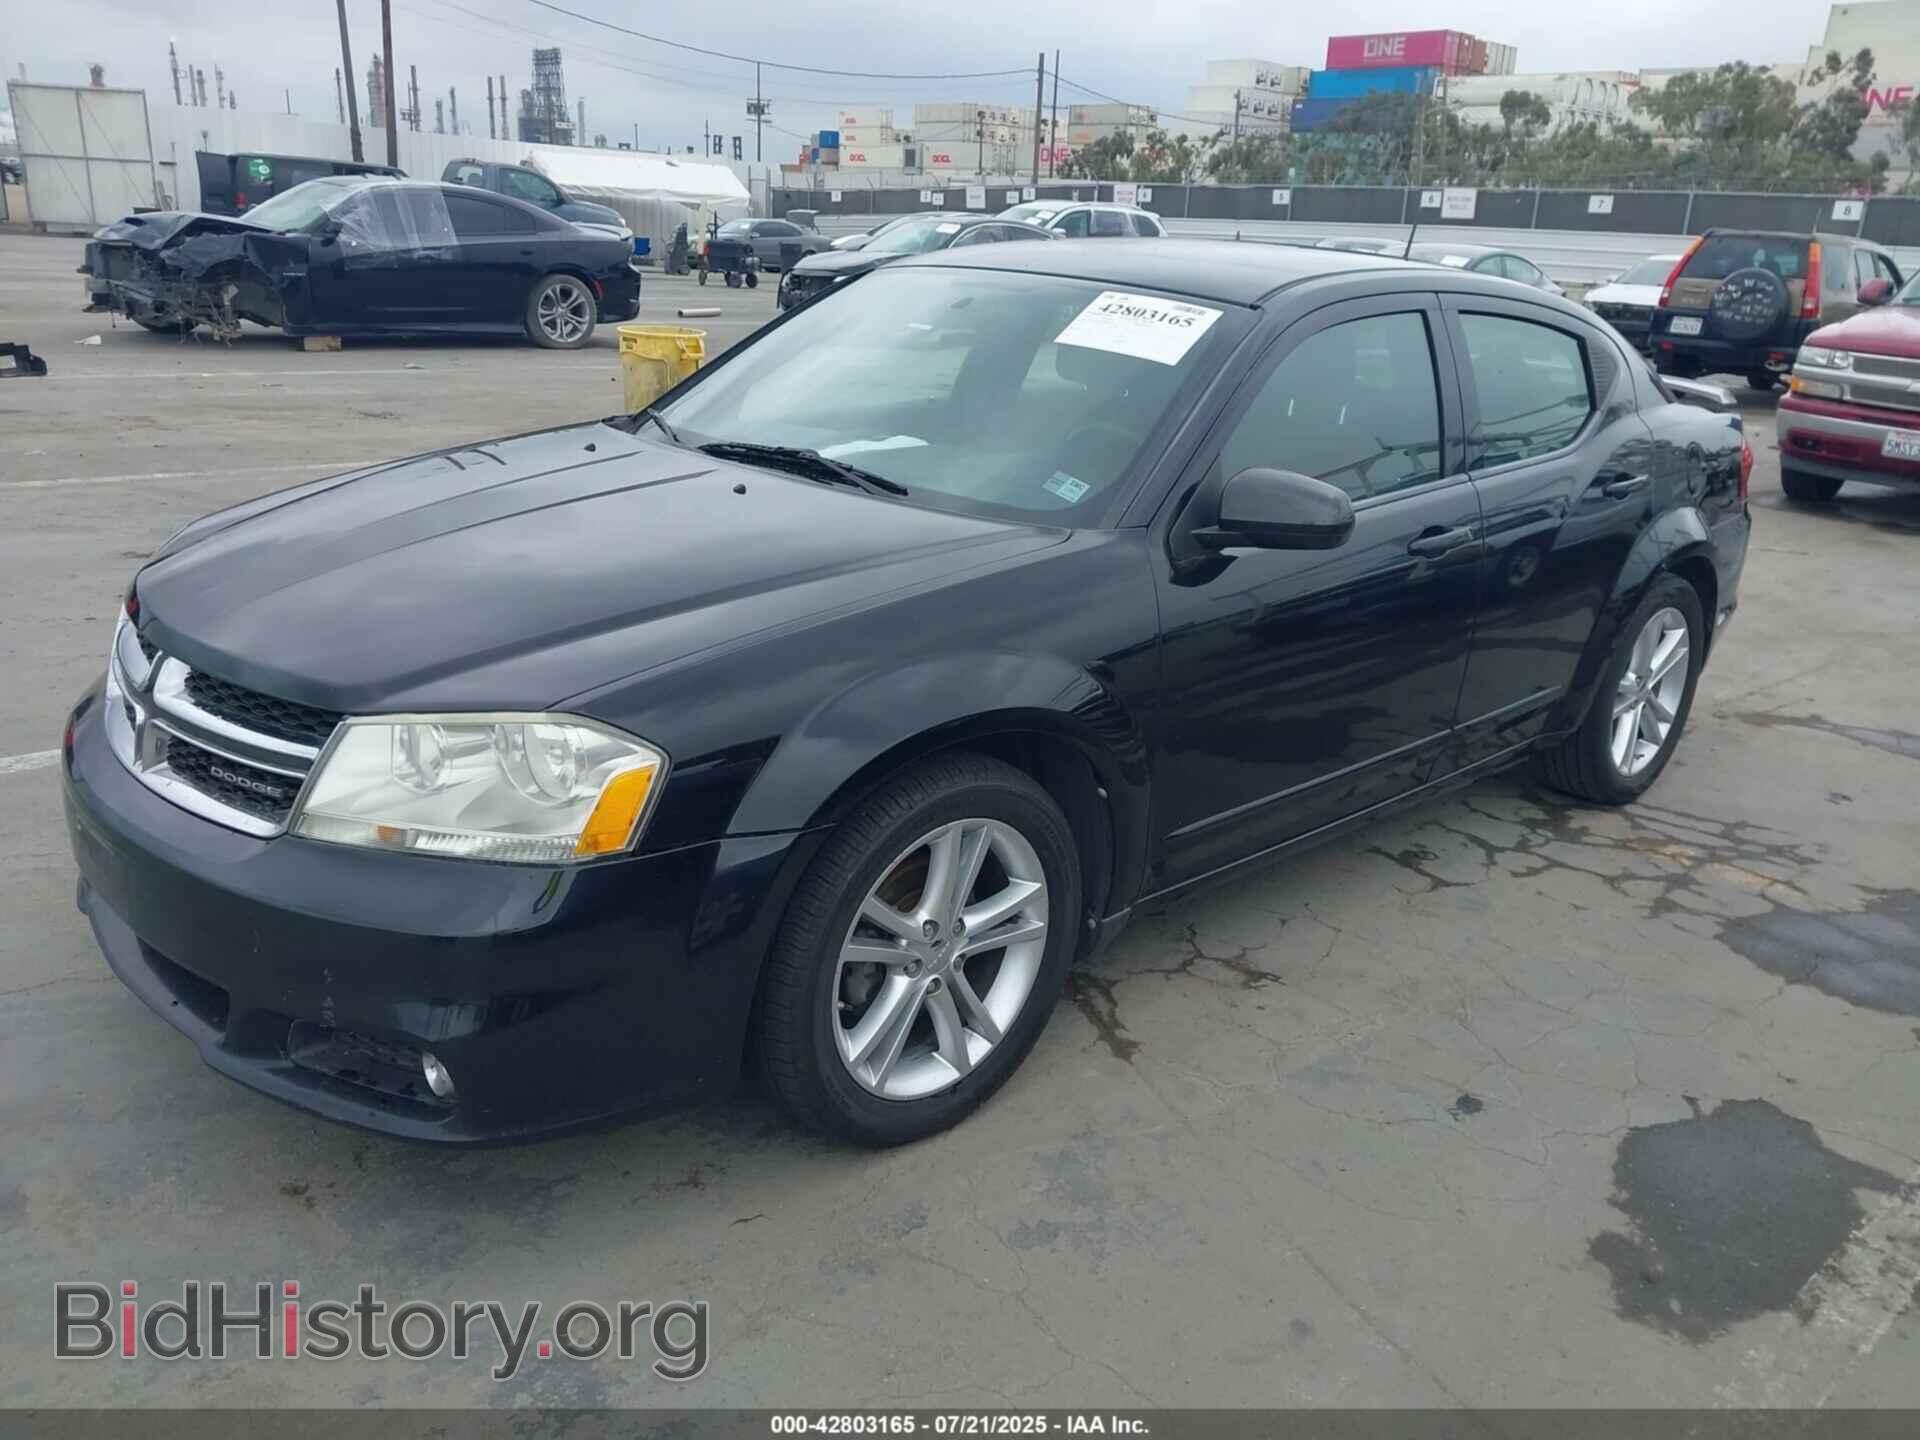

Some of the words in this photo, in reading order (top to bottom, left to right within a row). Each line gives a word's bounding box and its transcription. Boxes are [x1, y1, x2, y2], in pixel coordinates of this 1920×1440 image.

[1363, 37, 1405, 57] ONE
[1099, 303, 1195, 328] 42803165
[210, 766, 283, 798] DODGE
